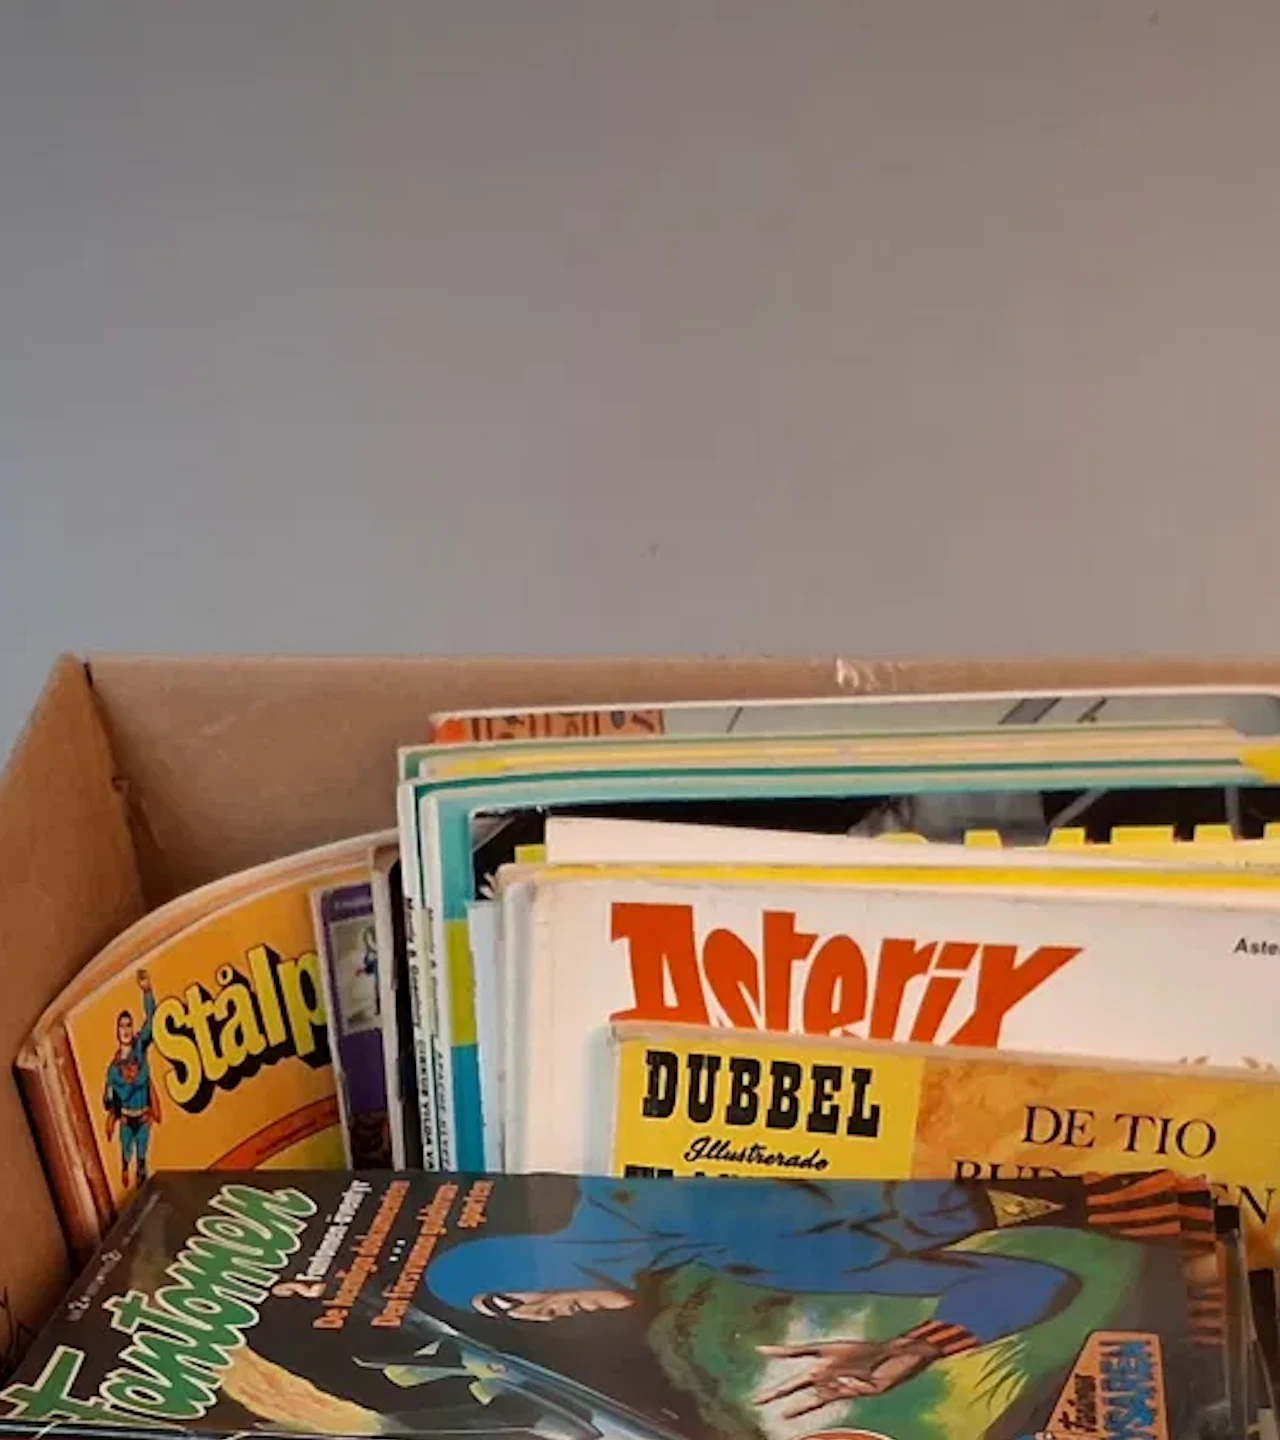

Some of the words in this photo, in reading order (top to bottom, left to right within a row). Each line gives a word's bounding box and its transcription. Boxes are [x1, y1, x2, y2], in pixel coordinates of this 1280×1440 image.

[152, 943, 327, 1108] Stålp
[610, 901, 1084, 1046] Asterix
[641, 1048, 882, 1138] DUBBEL
[1023, 1105, 1093, 1150] DE
[1117, 1112, 1216, 1159] TIO
